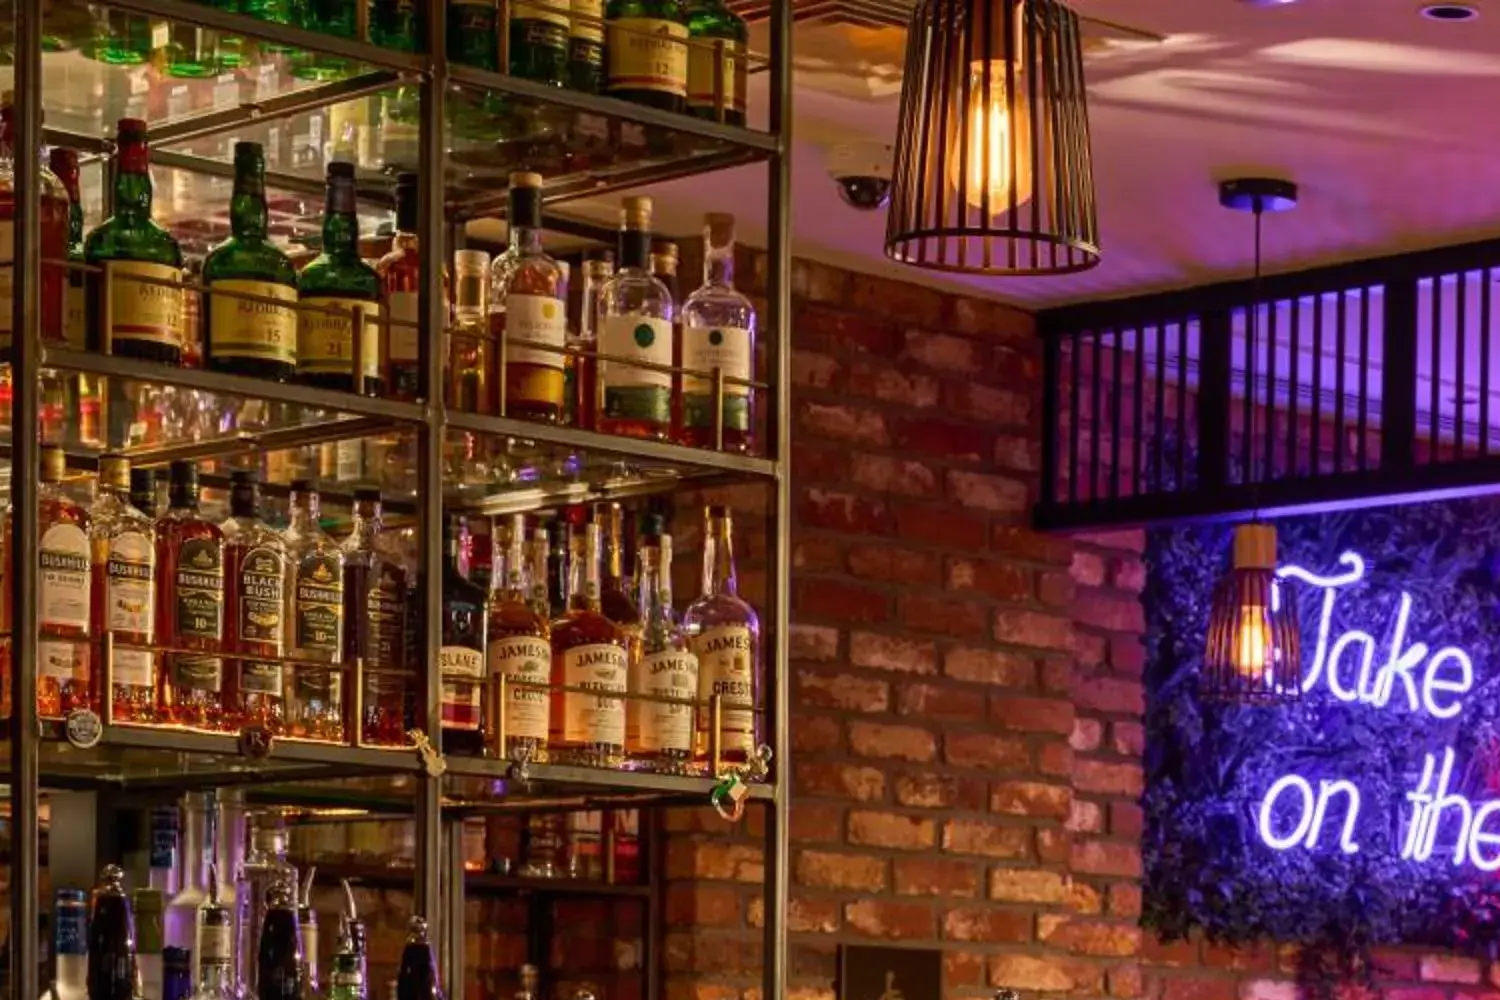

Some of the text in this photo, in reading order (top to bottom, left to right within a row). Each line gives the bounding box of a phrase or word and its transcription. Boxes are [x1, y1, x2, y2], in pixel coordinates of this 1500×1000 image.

[243, 574, 281, 588] BLACK
[245, 585, 280, 599] BUSH
[194, 617, 207, 630] 10
[1272, 551, 1473, 718] Take
[1259, 774, 1360, 853] on
